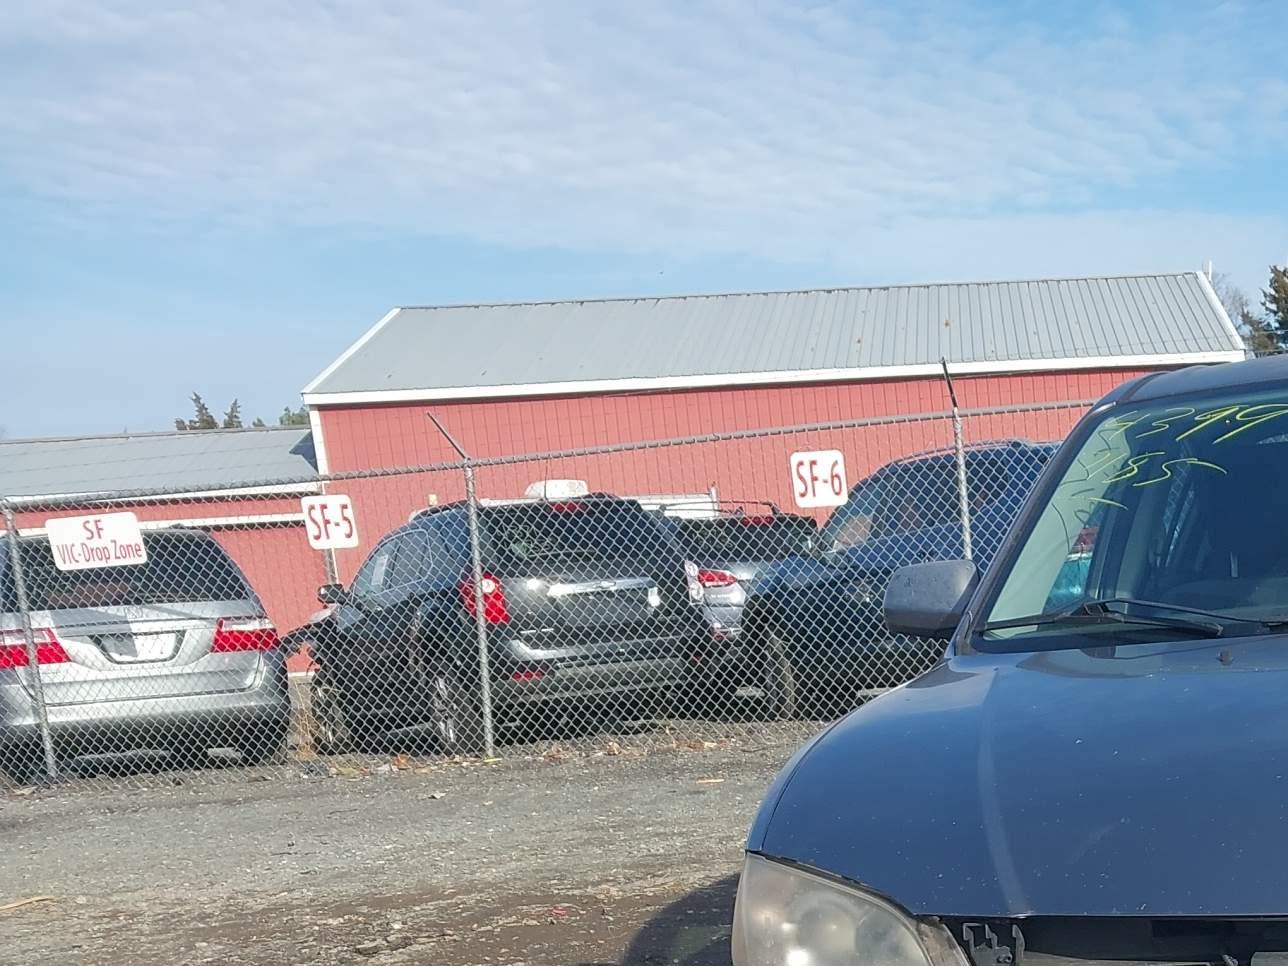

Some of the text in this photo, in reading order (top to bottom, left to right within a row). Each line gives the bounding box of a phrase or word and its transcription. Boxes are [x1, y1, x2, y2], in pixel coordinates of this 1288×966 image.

[795, 459, 842, 498] SF-6
[82, 519, 105, 540] SF
[307, 503, 354, 540] SF-5
[56, 539, 143, 564] VIC-Drop Zone
